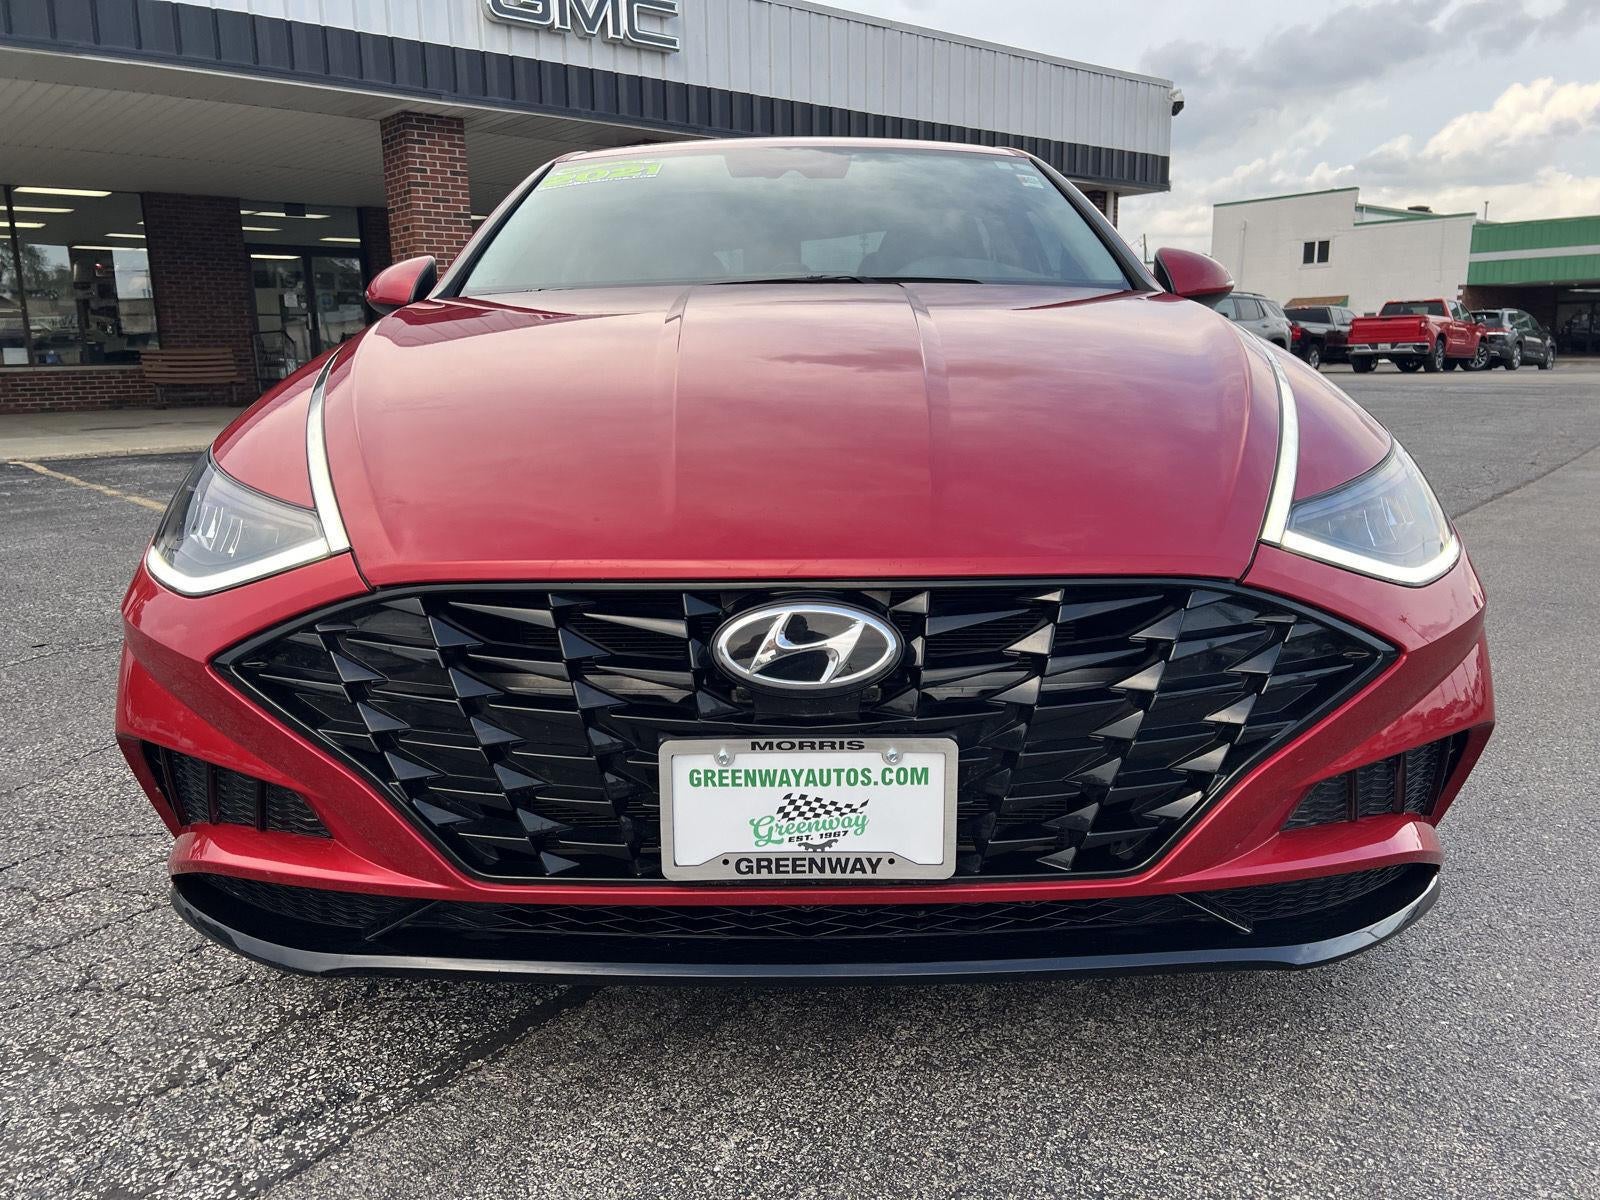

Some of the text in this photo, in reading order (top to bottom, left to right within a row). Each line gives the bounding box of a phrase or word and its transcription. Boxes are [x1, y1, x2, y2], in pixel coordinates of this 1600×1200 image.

[486, 0, 679, 51] GMC
[750, 740, 865, 751] MORRIS
[689, 767, 929, 787] GREENWAYAUTOS.COM
[749, 814, 869, 847] Greenway
[788, 830, 849, 843] EST. 1967
[734, 857, 883, 875] GREENWAY
